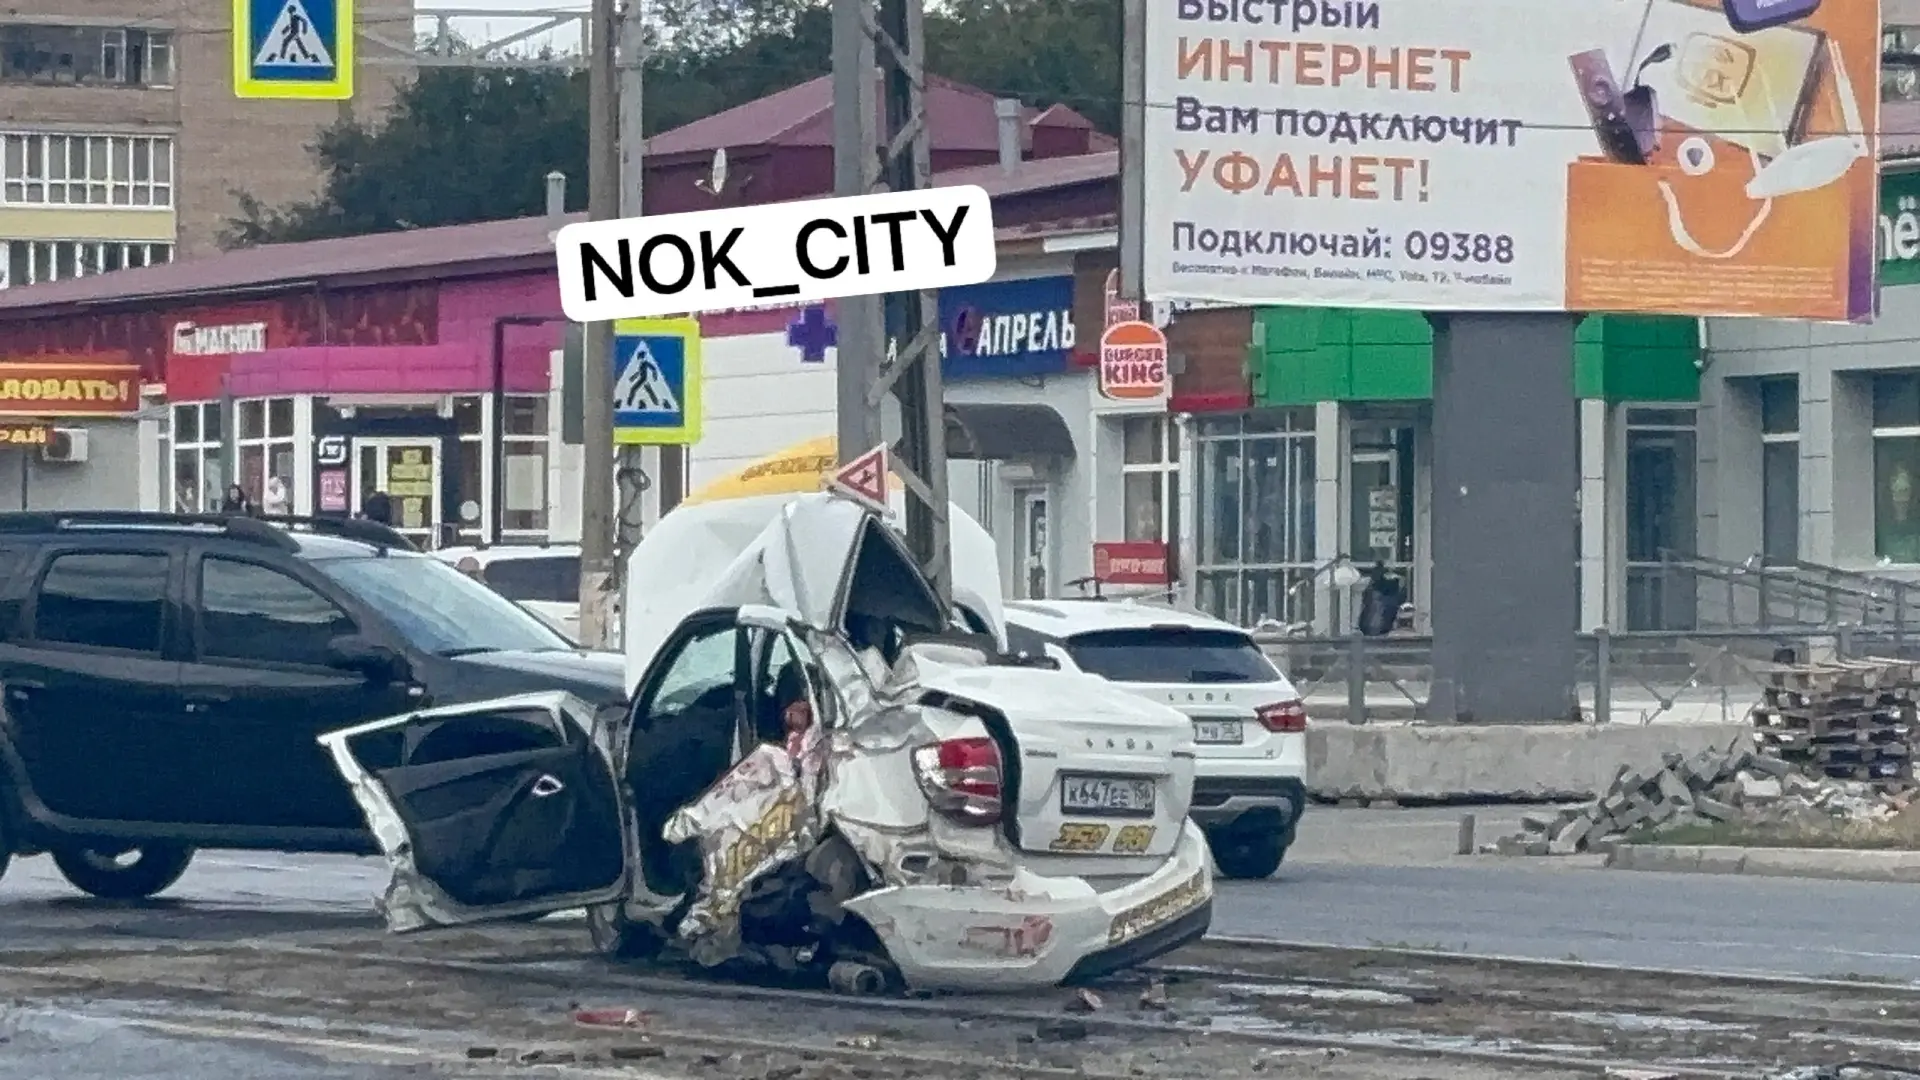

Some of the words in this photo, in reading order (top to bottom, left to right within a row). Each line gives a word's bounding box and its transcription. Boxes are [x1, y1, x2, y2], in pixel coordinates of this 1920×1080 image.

[1177, 36, 1472, 93] ИНТЕРНЕТ
[1175, 96, 1259, 135] Вам
[1275, 107, 1523, 147] подключит
[1173, 149, 1429, 202] УФАНЕТ!
[1172, 221, 1392, 258] Подключай:
[1404, 229, 1515, 264] 09388
[976, 309, 1077, 357] АПРЕЛЬ
[1104, 347, 1164, 362] BURGER
[0, 378, 130, 402] ЛОВАТЬ!
[1104, 362, 1164, 385] KING
